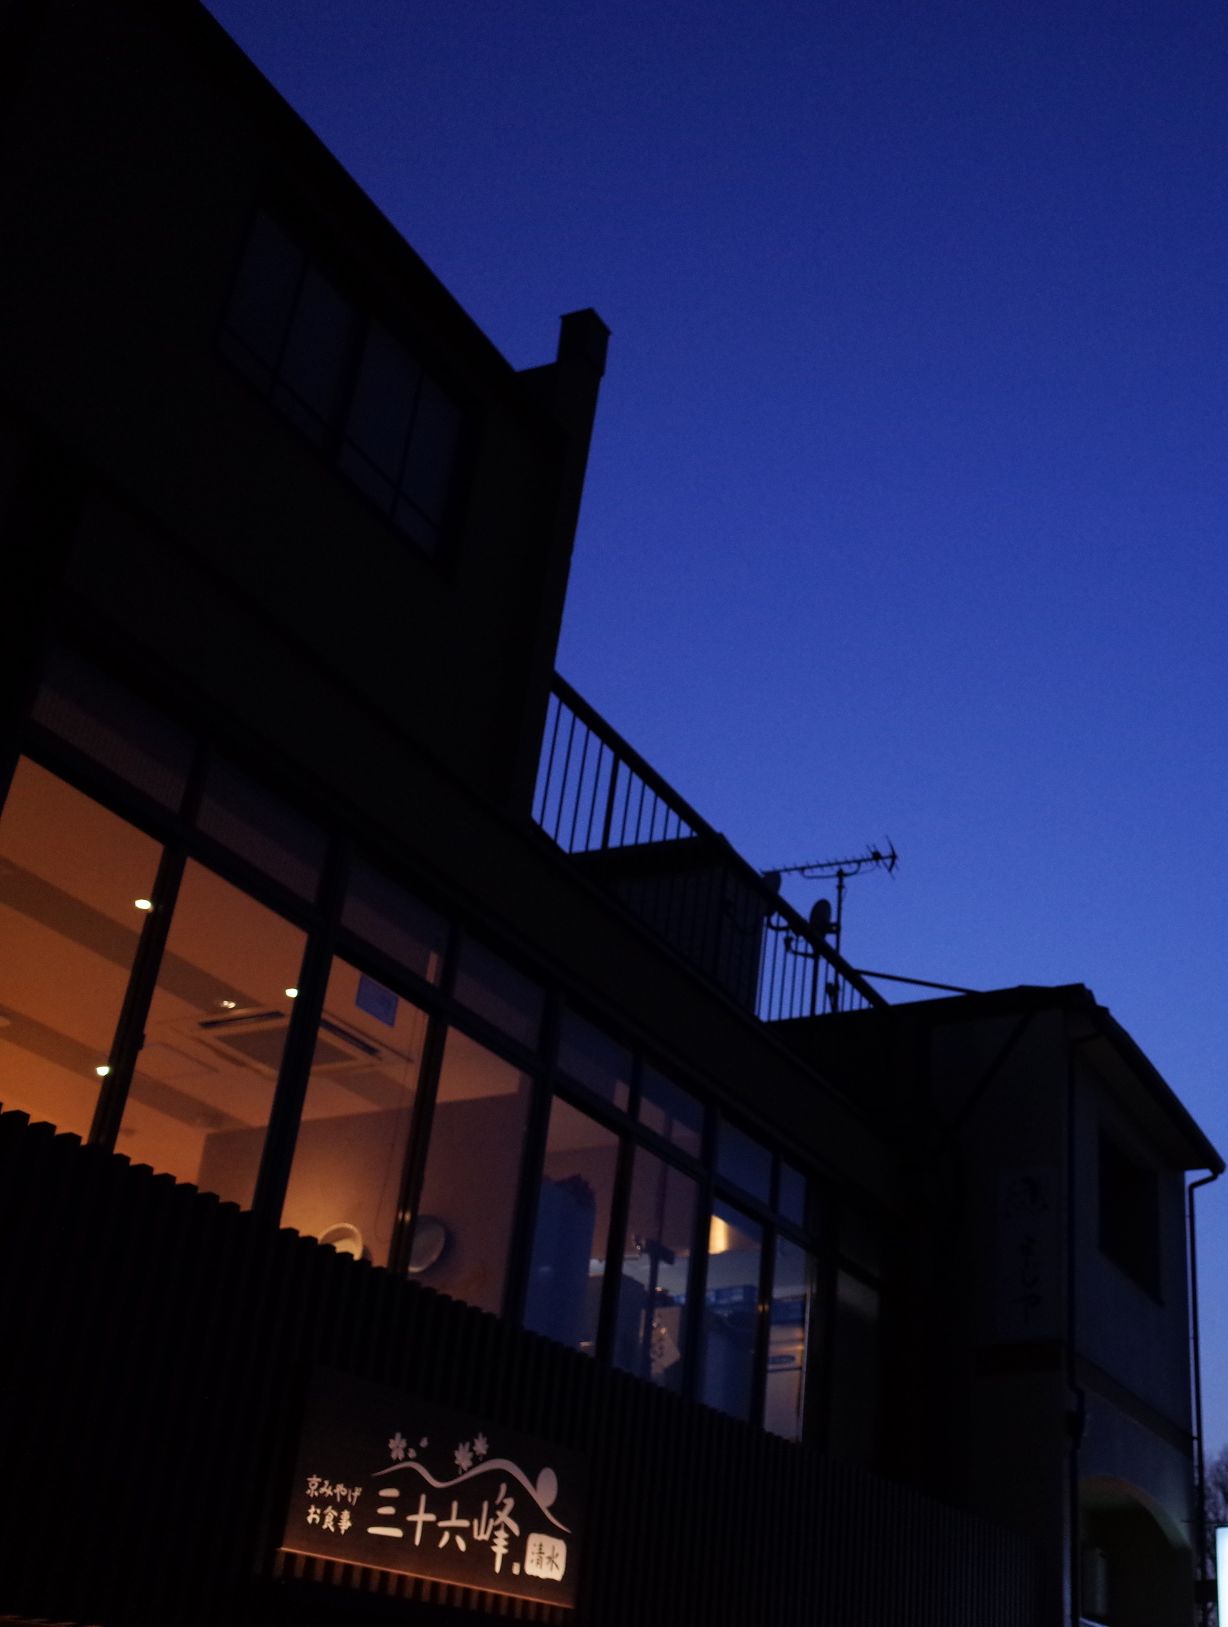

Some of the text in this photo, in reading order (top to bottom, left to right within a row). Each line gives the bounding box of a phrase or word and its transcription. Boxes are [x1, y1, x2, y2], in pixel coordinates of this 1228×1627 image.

[305, 1473, 363, 1506] 京みやげ
[305, 1503, 353, 1537] お食事
